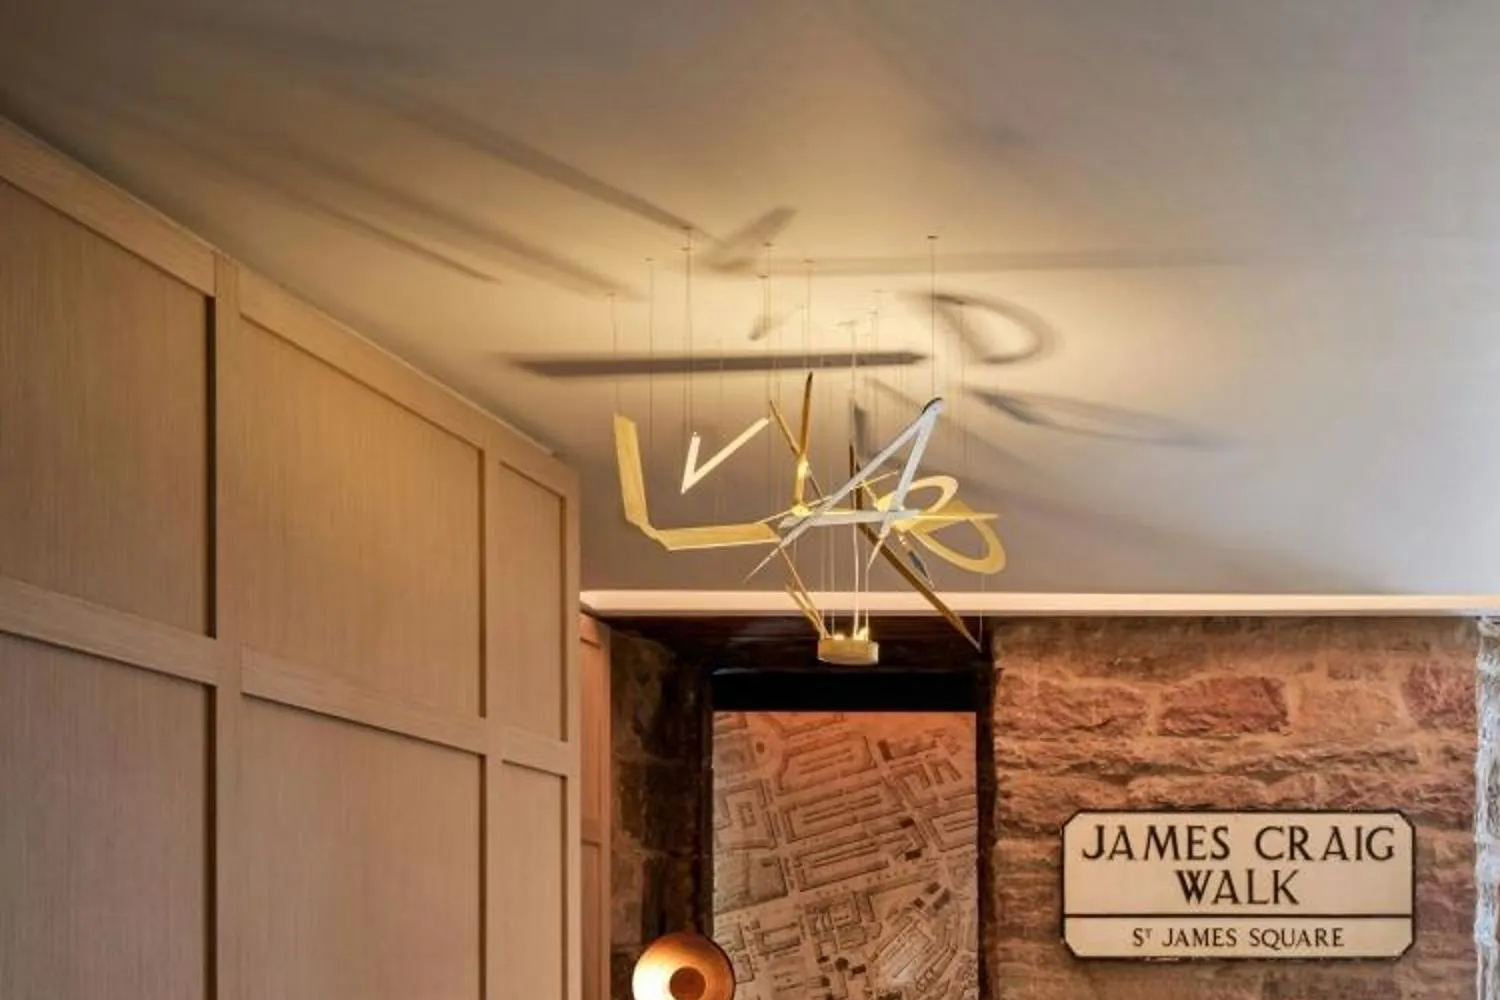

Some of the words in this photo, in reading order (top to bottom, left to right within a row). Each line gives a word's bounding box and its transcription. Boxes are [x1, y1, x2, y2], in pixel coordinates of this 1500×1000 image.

[1082, 825, 1230, 861] JAMES
[1255, 825, 1395, 861] CRAIG
[1174, 868, 1300, 905] WALK
[1161, 928, 1238, 947] JAMES
[1249, 928, 1345, 951] SQUARE
